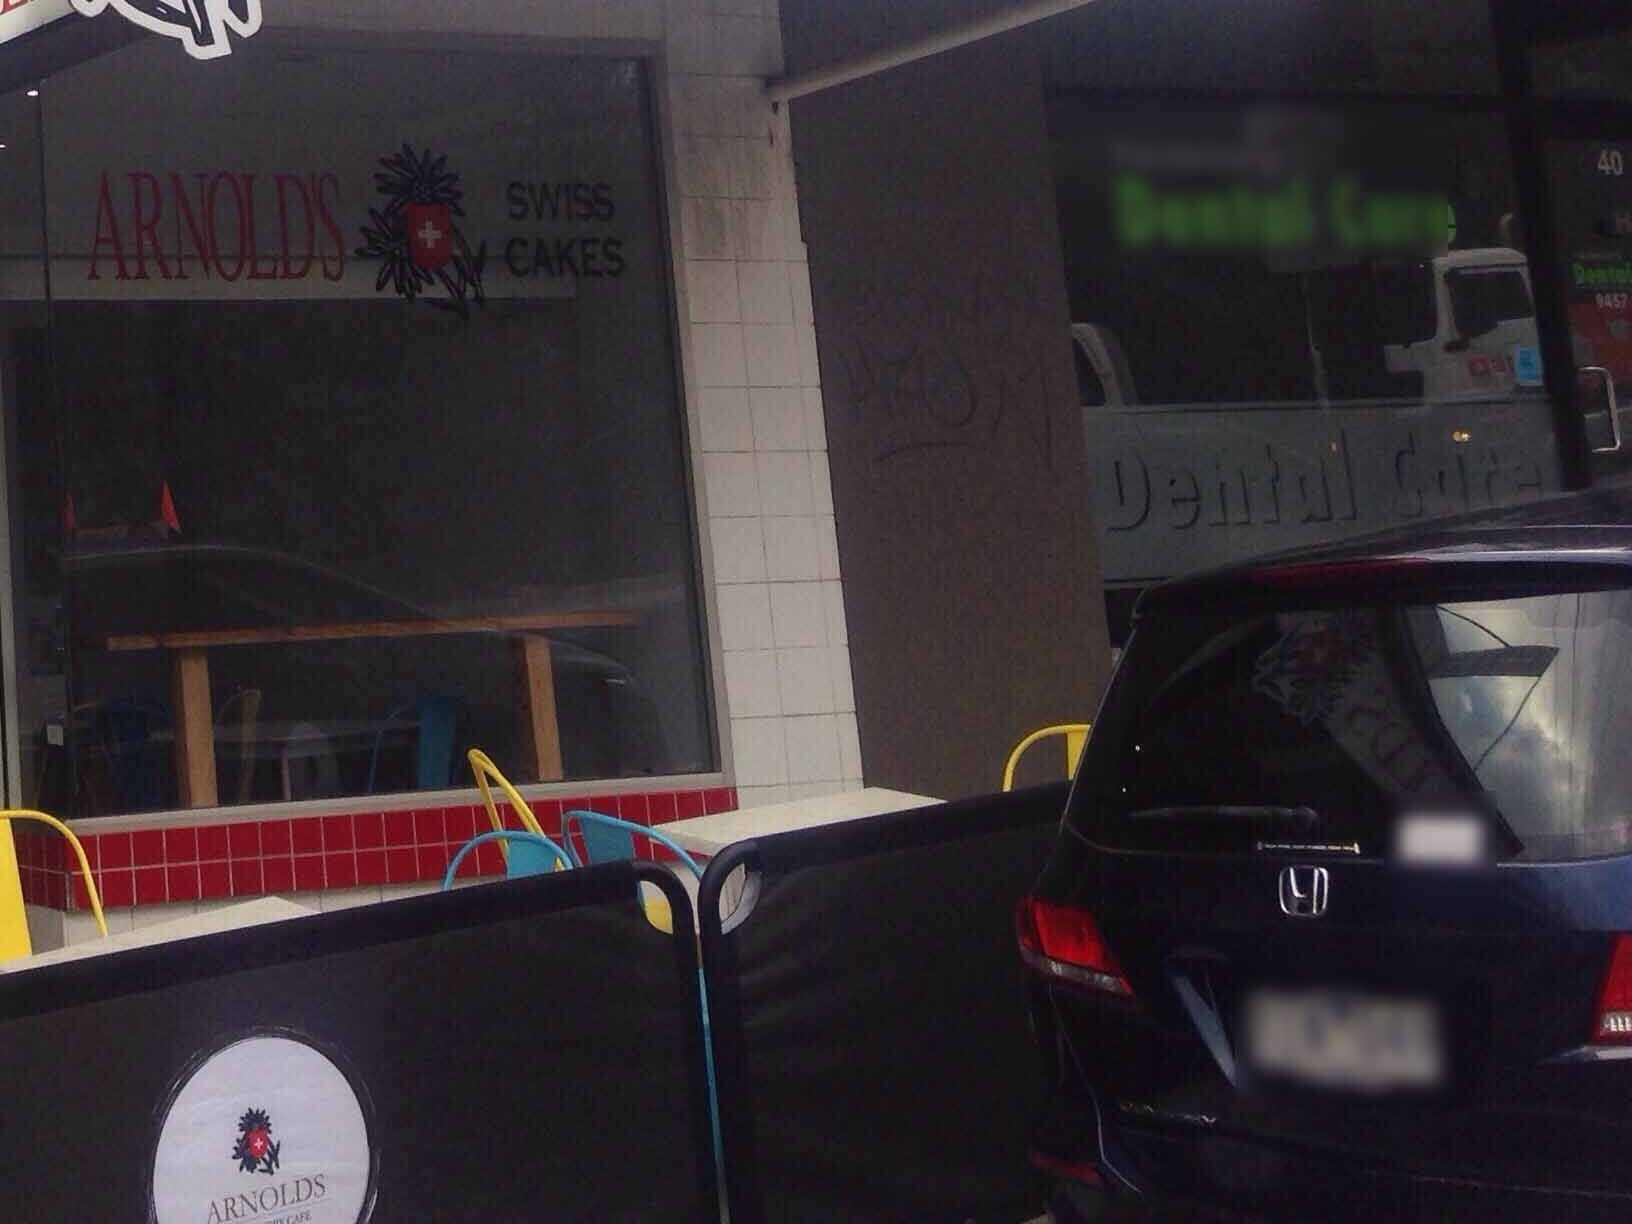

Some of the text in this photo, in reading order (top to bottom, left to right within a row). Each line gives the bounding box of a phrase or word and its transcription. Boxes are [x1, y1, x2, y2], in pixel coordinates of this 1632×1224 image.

[1597, 149, 1624, 176] 40
[504, 180, 617, 223] SWISS
[86, 170, 346, 282] ARNOLD'S
[503, 236, 626, 278] CAKES
[1105, 428, 1358, 531] Dental
